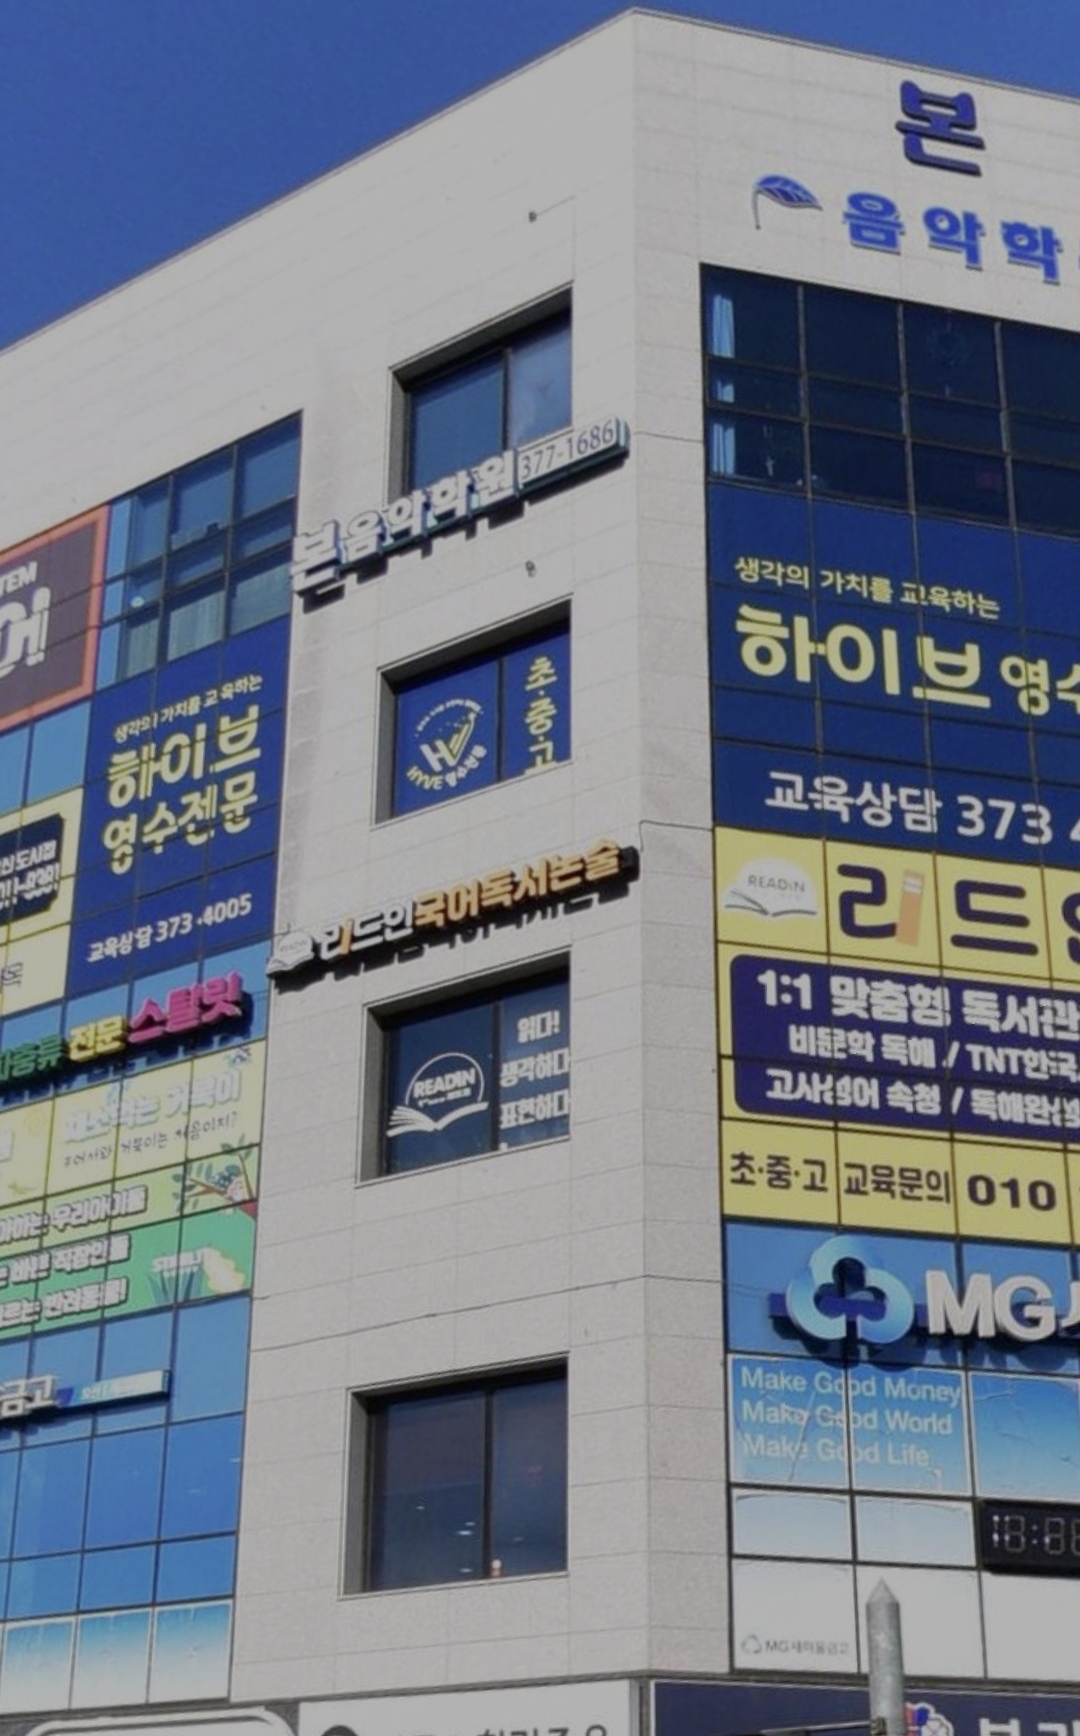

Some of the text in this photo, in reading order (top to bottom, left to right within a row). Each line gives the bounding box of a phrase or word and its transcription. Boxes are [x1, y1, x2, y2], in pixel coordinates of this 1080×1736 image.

[895, 80, 985, 177] 본
[843, 192, 1080, 285] 음악학
[521, 421, 614, 480] 377-1686
[735, 556, 1000, 620] 생각의 가치를 교육하는
[735, 604, 992, 709] 하이브
[108, 704, 262, 808] 하이브
[765, 770, 943, 834] 교육상담
[957, 794, 1053, 846] 373
[87, 924, 152, 963] 교육상담
[155, 912, 194, 943] 373
[757, 970, 813, 1010] 1:1
[830, 975, 951, 1028] 맞춤형
[67, 1014, 128, 1063] 전문
[789, 1024, 875, 1062] 비문학
[881, 1033, 936, 1069] 독해
[965, 1043, 1080, 1083] TNT한국
[413, 1068, 477, 1099] READIN
[766, 1068, 879, 1109] 고사성어
[844, 1162, 951, 1204] 교육문의
[967, 1175, 1057, 1212] 010
[740, 1366, 963, 1408] Make Good Money
[742, 1401, 954, 1435] Make Good World
[743, 1434, 807, 1459] Make
[817, 1438, 879, 1463] Good
